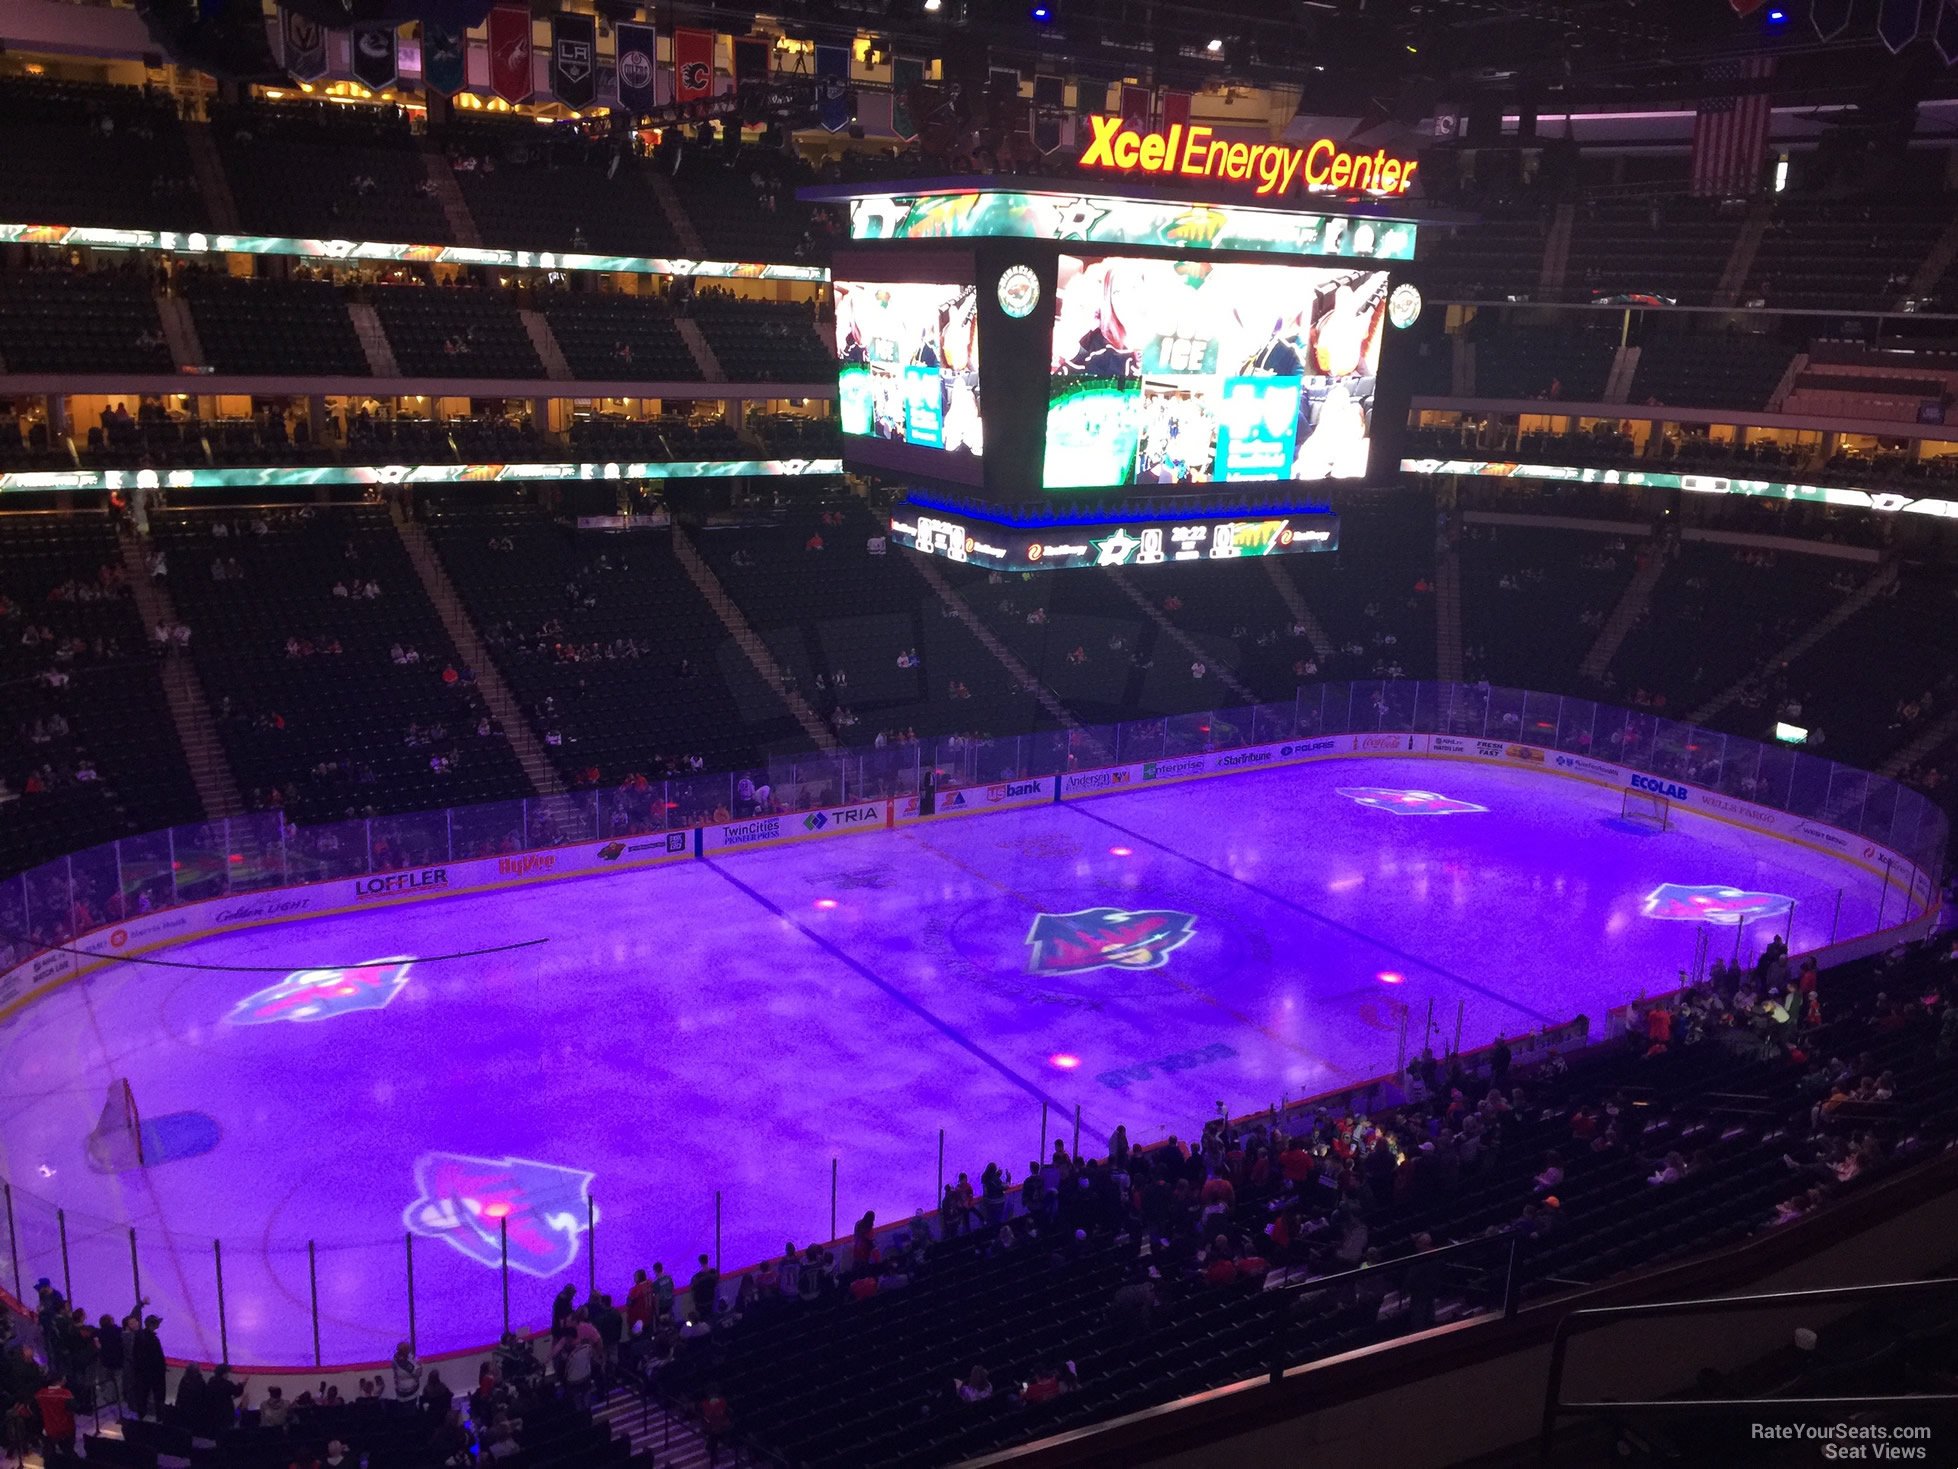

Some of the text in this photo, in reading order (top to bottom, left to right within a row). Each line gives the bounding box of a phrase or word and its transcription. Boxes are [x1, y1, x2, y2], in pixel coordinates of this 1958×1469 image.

[1079, 115, 1418, 194] Xcel Energy Center
[1294, 740, 1335, 753] POLARIS
[1631, 773, 1689, 801] ECOLAB
[832, 807, 878, 825] TRIA
[355, 868, 448, 896] LOFFLER
